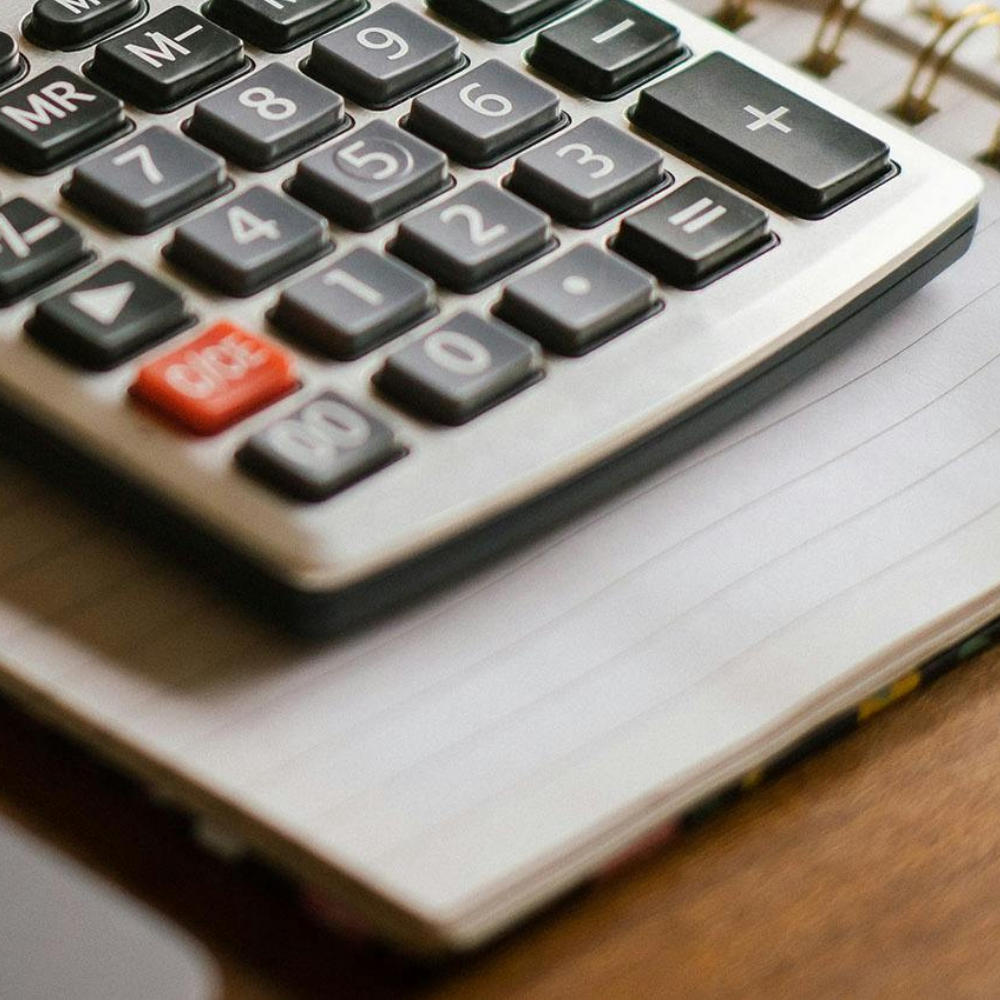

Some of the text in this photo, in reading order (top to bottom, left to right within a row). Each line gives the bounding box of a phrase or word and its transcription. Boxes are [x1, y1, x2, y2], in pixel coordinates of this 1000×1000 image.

[356, 26, 408, 60] 9
[1, 80, 96, 133] MR
[239, 87, 297, 121] 8
[459, 82, 512, 117] 6
[112, 145, 163, 184] 7
[337, 140, 399, 180] 5
[556, 143, 614, 179] 3
[227, 205, 281, 245] 4
[439, 204, 508, 246] 2
[323, 269, 383, 306] 1
[424, 331, 491, 374] 0
